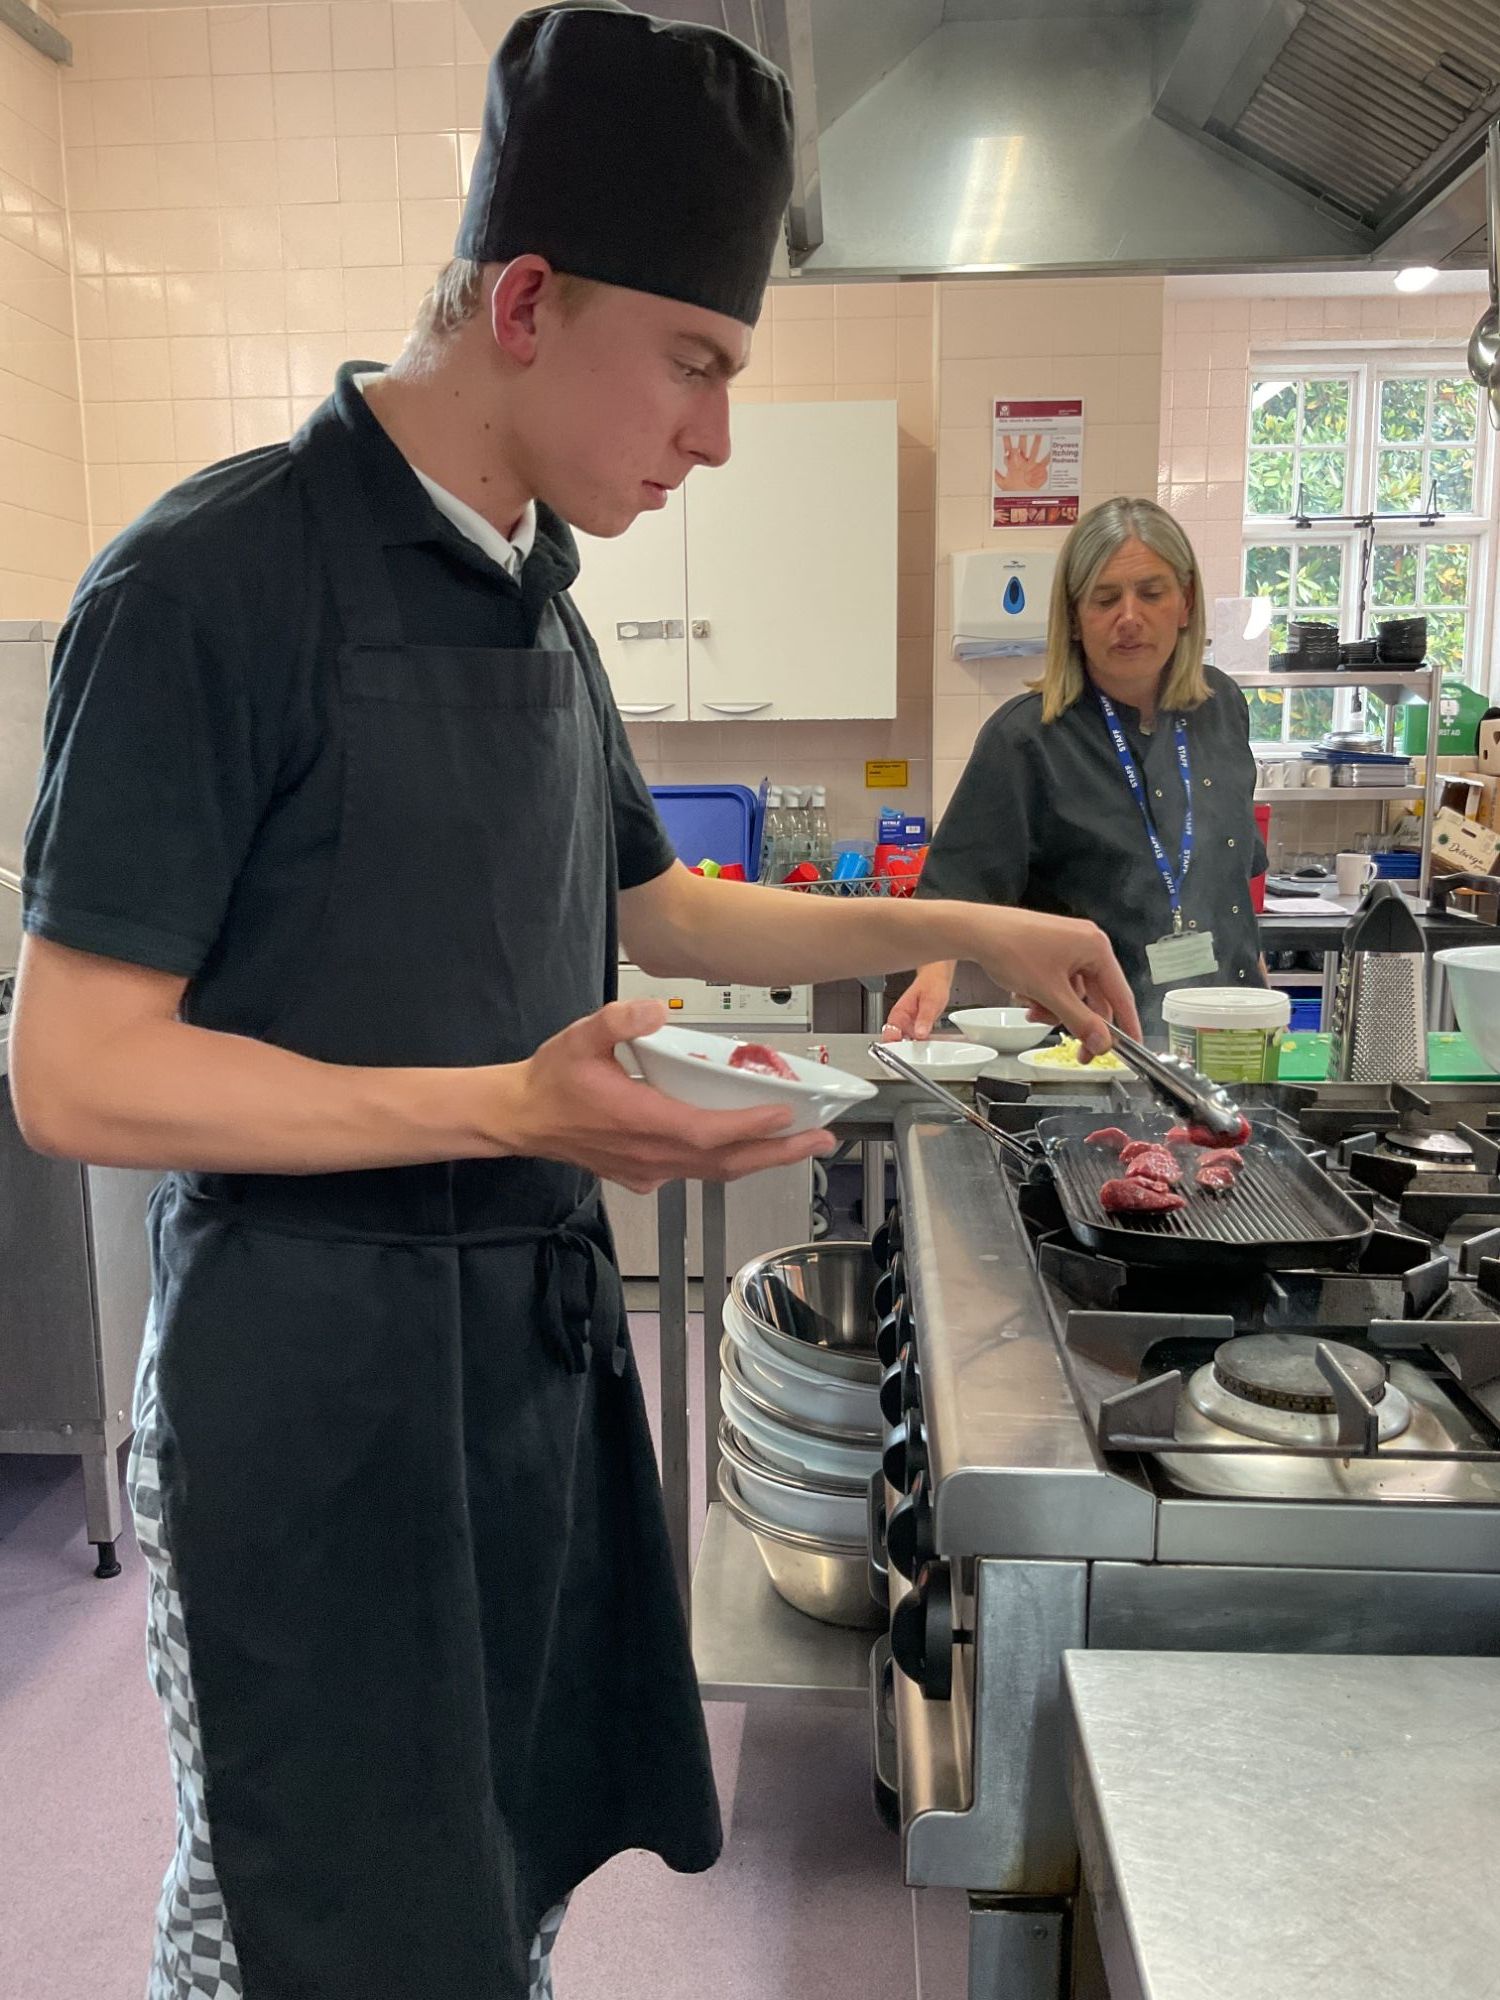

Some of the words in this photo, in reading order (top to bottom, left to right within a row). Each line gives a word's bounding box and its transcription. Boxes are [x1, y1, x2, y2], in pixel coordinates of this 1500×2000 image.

[1052, 450, 1079, 458] Itching
[1100, 696, 1114, 717] STAFF
[1112, 729, 1126, 752] STAFF
[1177, 745, 1188, 768] STAFF
[1125, 765, 1138, 788] STAFF
[1150, 835, 1163, 859] STAFF
[1162, 870, 1176, 894] STAFF
